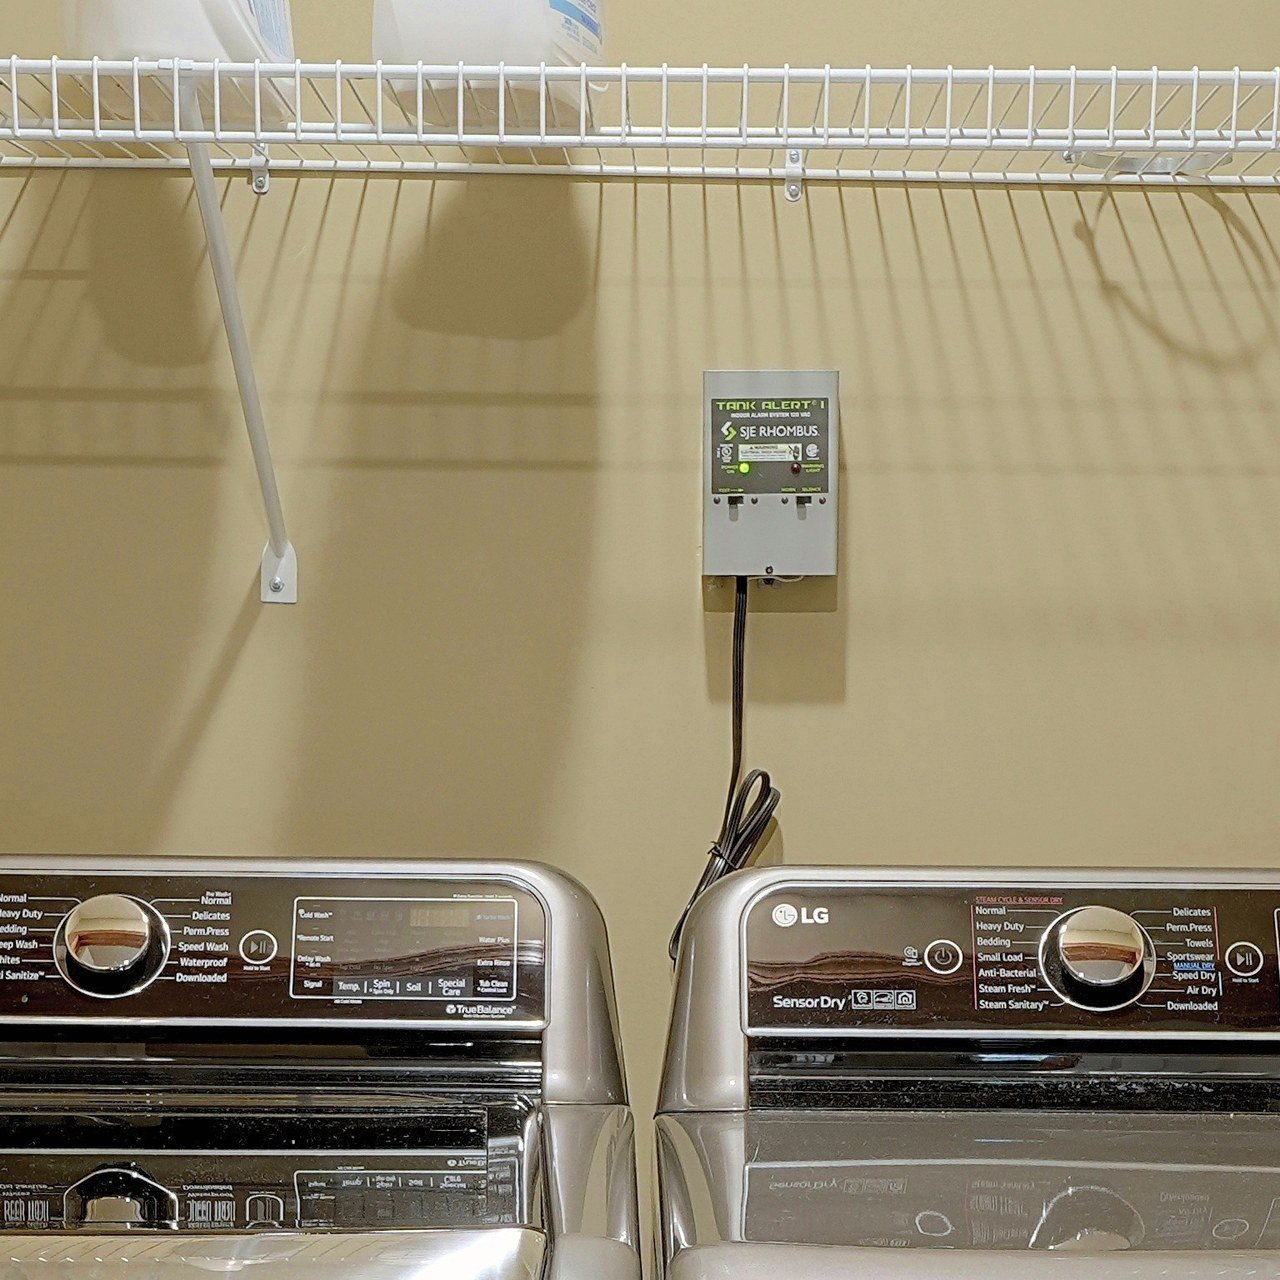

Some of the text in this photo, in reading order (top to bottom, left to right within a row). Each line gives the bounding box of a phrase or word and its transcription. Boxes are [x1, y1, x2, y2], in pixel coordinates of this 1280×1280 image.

[716, 401, 756, 410] TANK
[740, 426, 756, 440] SJE
[201, 896, 232, 905] Normal
[975, 896, 997, 904] STEAM
[1023, 896, 1049, 904] SENSOR
[22, 908, 43, 920] Duty
[801, 907, 829, 924] LG
[975, 906, 1006, 915] Normal
[1172, 907, 1212, 917] Delicates
[192, 911, 231, 921] Delicates
[183, 926, 230, 936] Perm.Press
[976, 921, 1025, 933] Heavy Duty
[1166, 922, 1213, 932] Perm.Press
[15, 939, 38, 949] Wash
[497, 936, 511, 944] Plus
[977, 936, 1011, 948] Bedding
[1185, 938, 1214, 948] Towels
[178, 942, 229, 953] Speed Wash
[297, 955, 314, 963] Delay
[977, 952, 1023, 962] Small Load
[1166, 951, 1215, 962] Sportswear
[179, 957, 228, 969] Waterproof
[477, 959, 511, 967] Extra Rinse
[1173, 962, 1215, 970] MANUAL DRY
[176, 973, 228, 982] Downloaded
[978, 968, 1037, 978] Anti-Bacterial
[1172, 970, 1216, 982] Speed Dry
[303, 980, 323, 989] Signal
[338, 981, 361, 992] Temp.
[373, 979, 391, 989] Spin
[406, 982, 422, 992] Soil
[438, 978, 466, 989] Special
[491, 980, 509, 988] Clean
[979, 983, 1006, 994] Steam
[442, 987, 461, 996] Care
[1186, 985, 1218, 997] Air Dry
[979, 999, 1007, 1009] Steam
[1167, 1001, 1218, 1011] Downloaded
